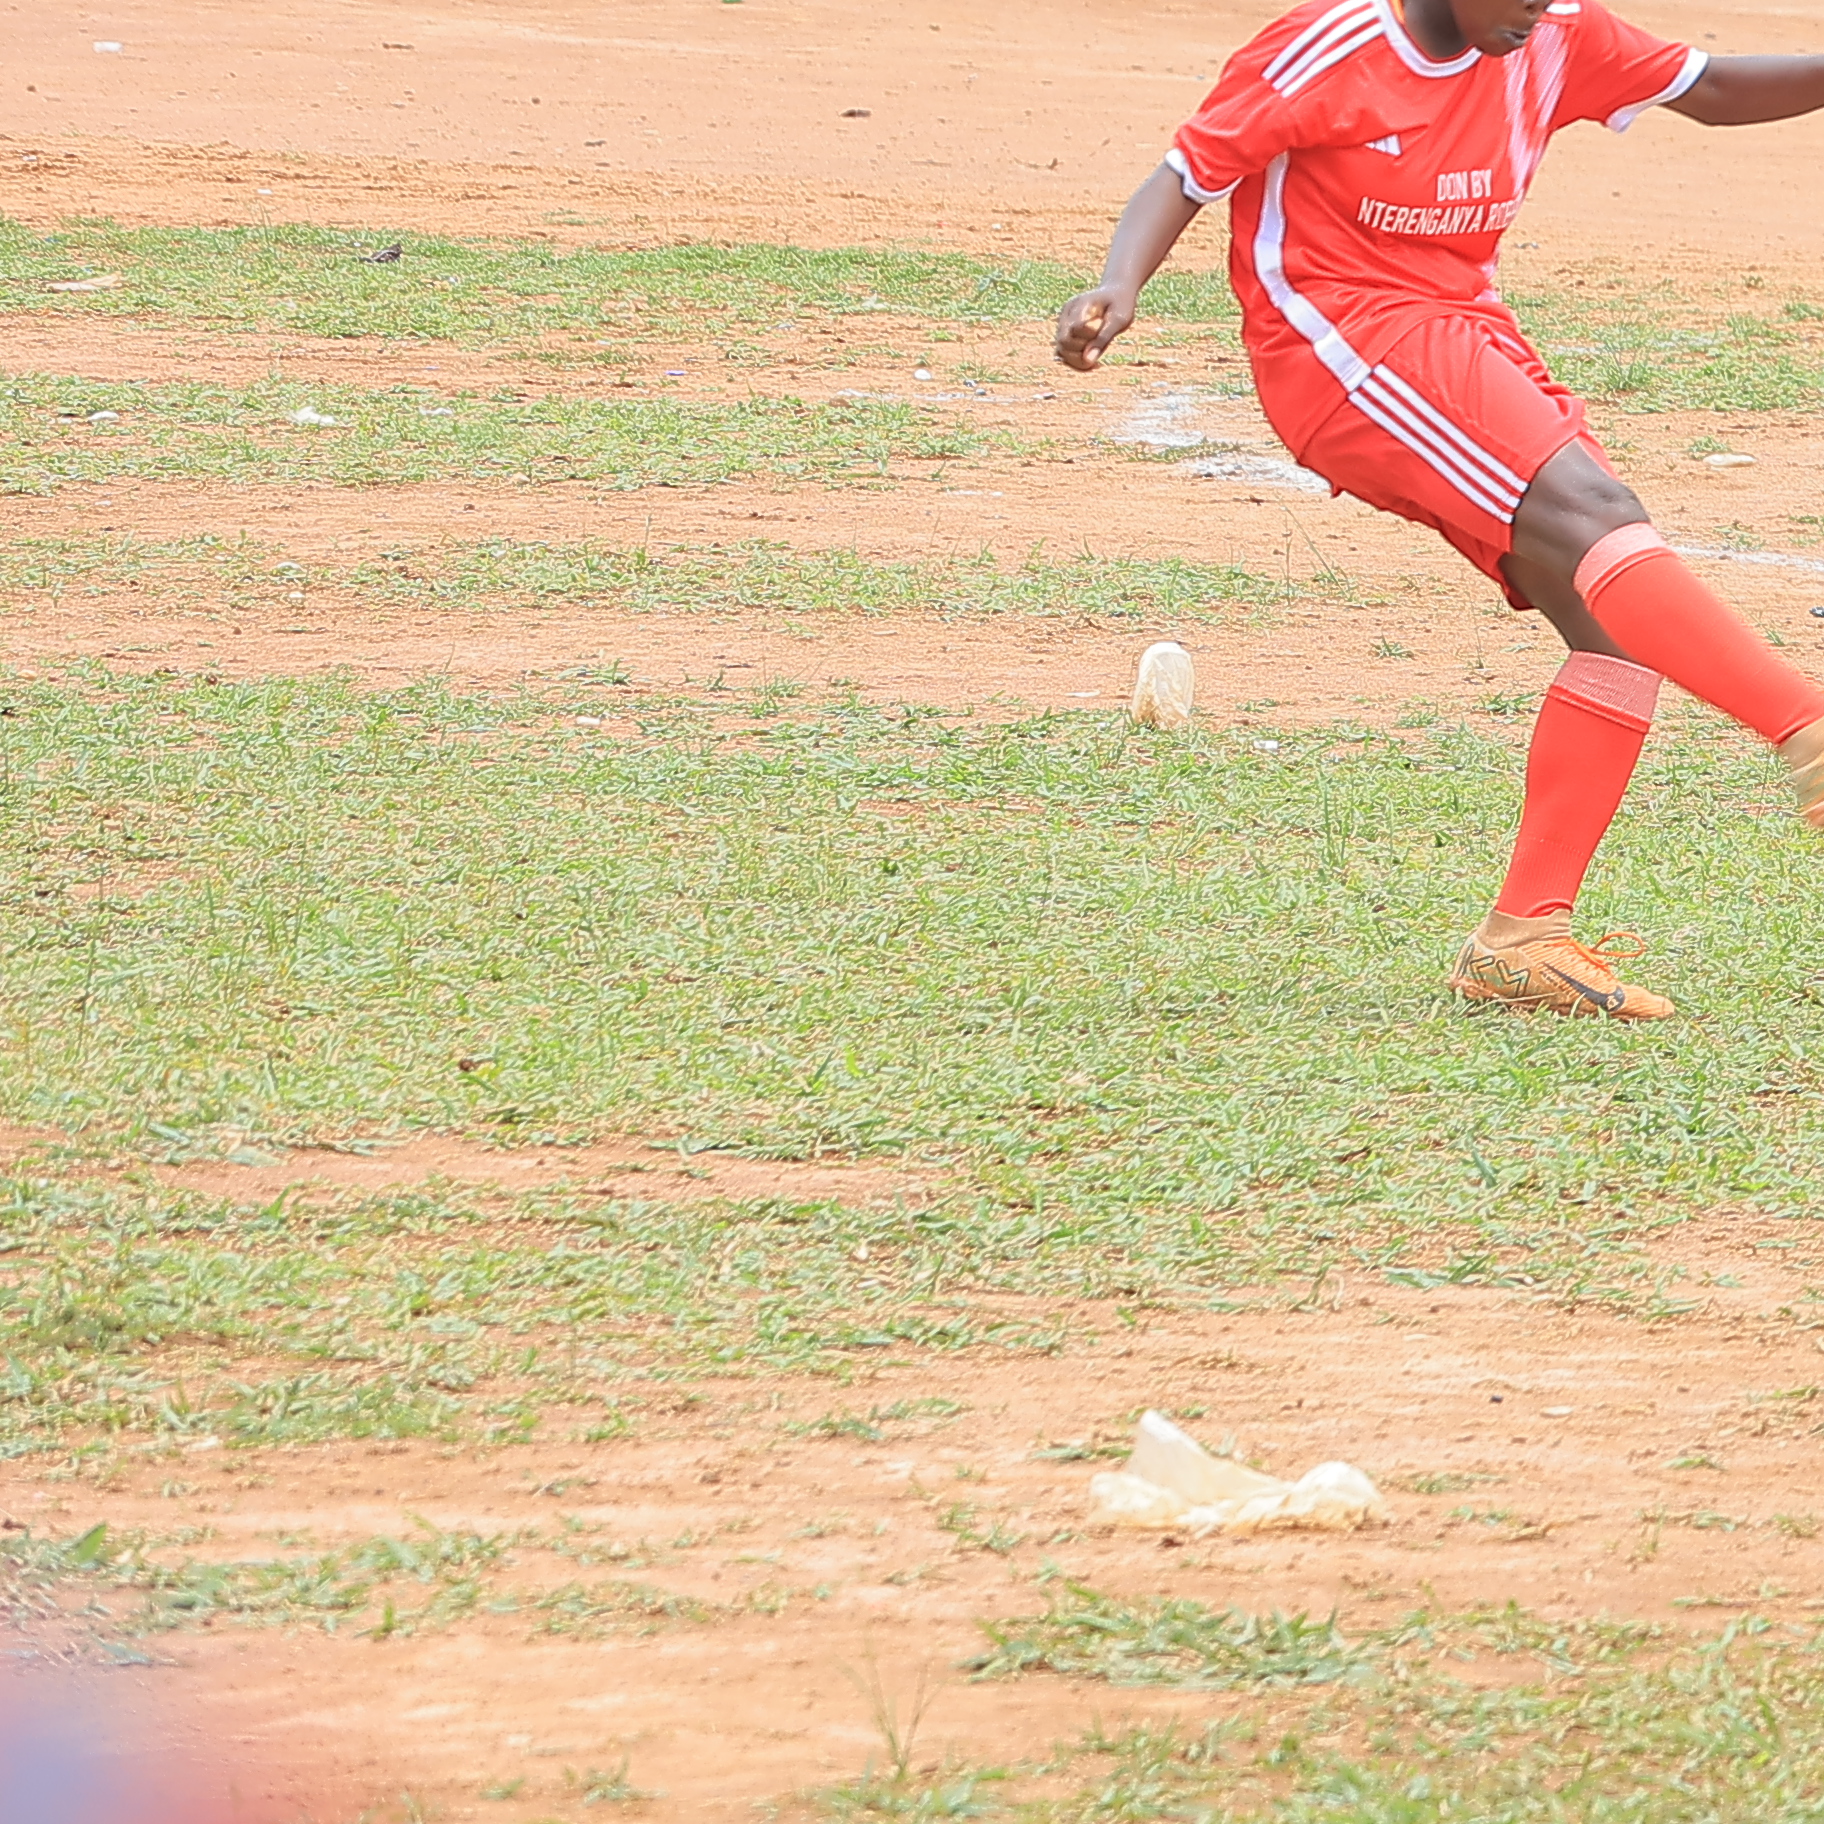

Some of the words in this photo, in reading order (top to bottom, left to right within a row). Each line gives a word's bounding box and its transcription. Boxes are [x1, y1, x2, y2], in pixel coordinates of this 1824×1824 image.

[1437, 171, 1468, 201] DON
[1471, 169, 1493, 198] BY
[1357, 196, 1485, 235] NTERENGANYA
